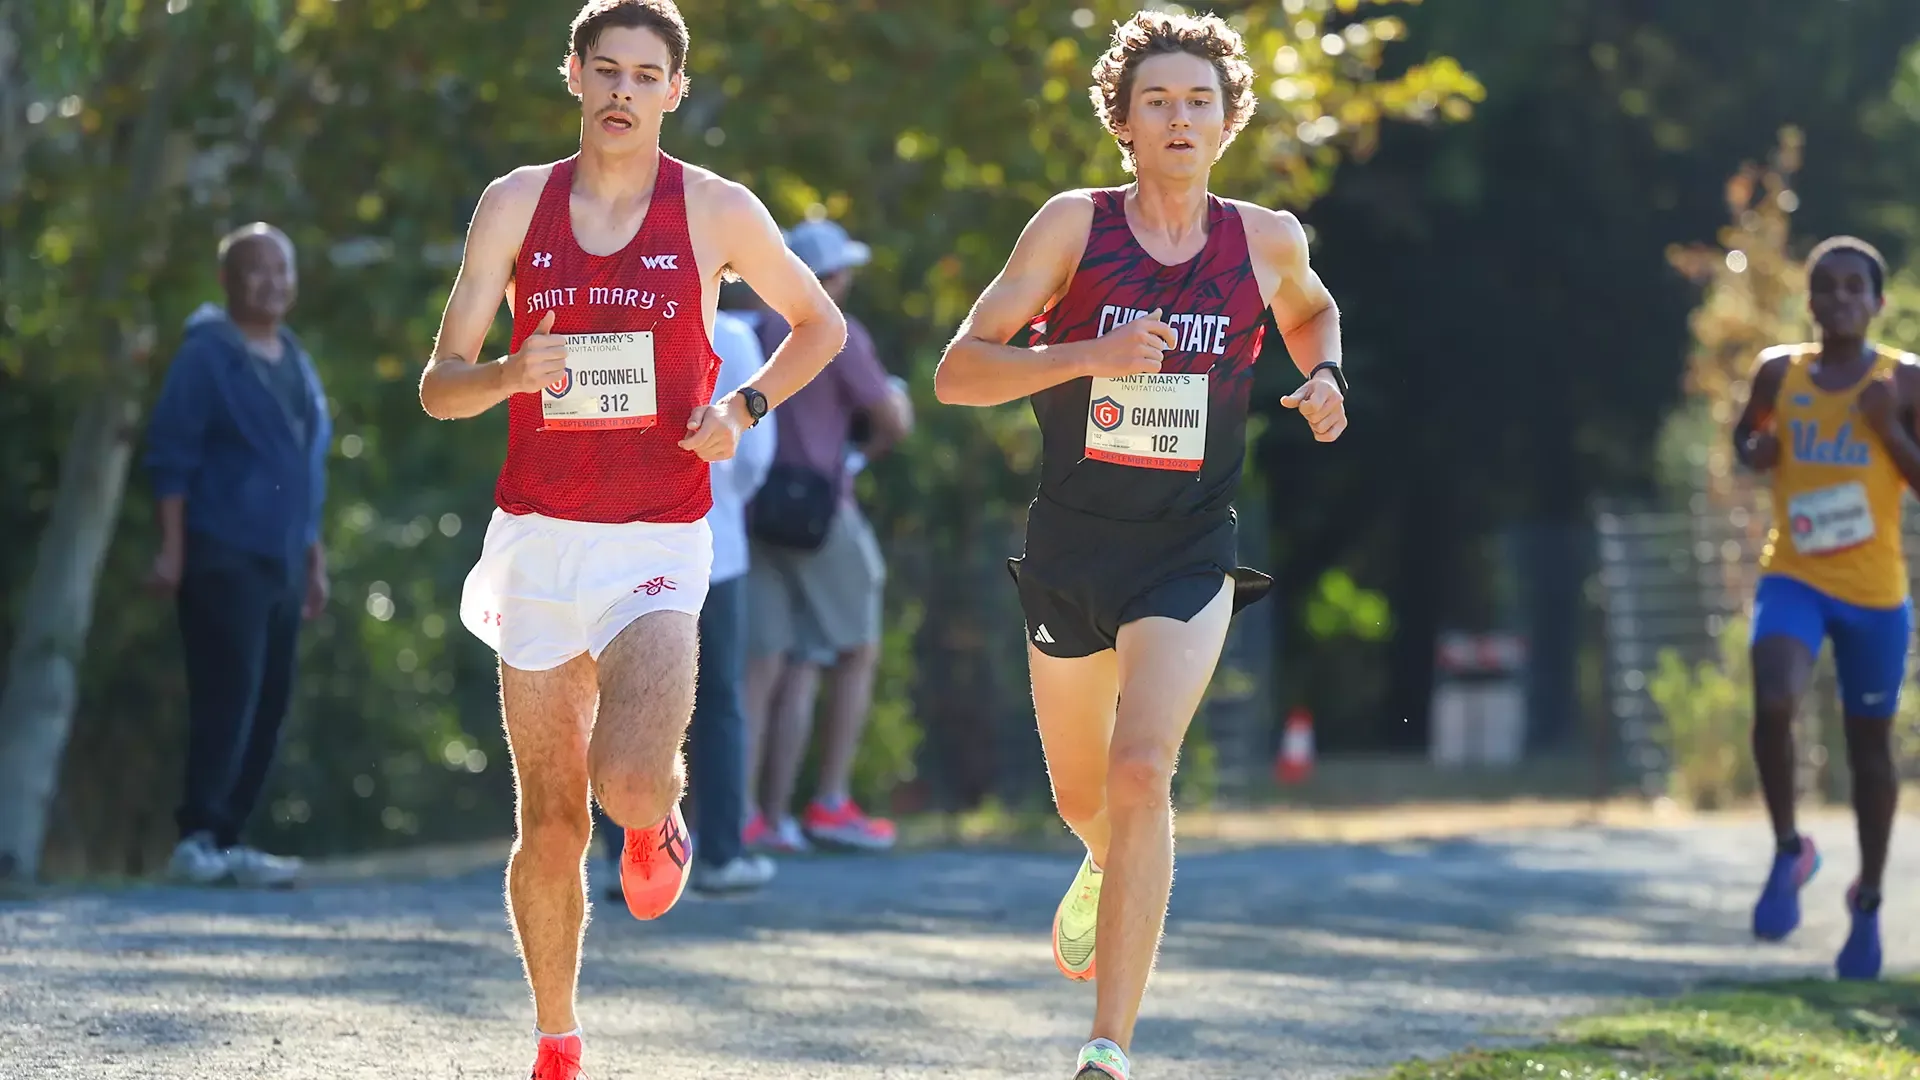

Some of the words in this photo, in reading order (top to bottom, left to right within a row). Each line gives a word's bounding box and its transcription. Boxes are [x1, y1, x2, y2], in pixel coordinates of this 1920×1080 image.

[640, 255, 678, 270] WCC
[527, 287, 577, 313] SAINT
[589, 287, 679, 319] MARY'S
[566, 336, 587, 345] INT
[590, 334, 634, 344] MARY'S
[1163, 314, 1230, 355] STATE
[569, 345, 622, 353] NVITATIONAL
[580, 368, 648, 386] O'CONNELL
[1148, 375, 1190, 385] MARY'S
[1121, 384, 1176, 393] INVITATIONAL
[600, 393, 629, 413] 312
[1100, 407, 1112, 424] G
[1131, 407, 1199, 428] GIANNINI
[559, 420, 606, 428] SEPTEMBER
[1151, 434, 1178, 453] 102
[1101, 451, 1152, 465] SEPTEMBER
